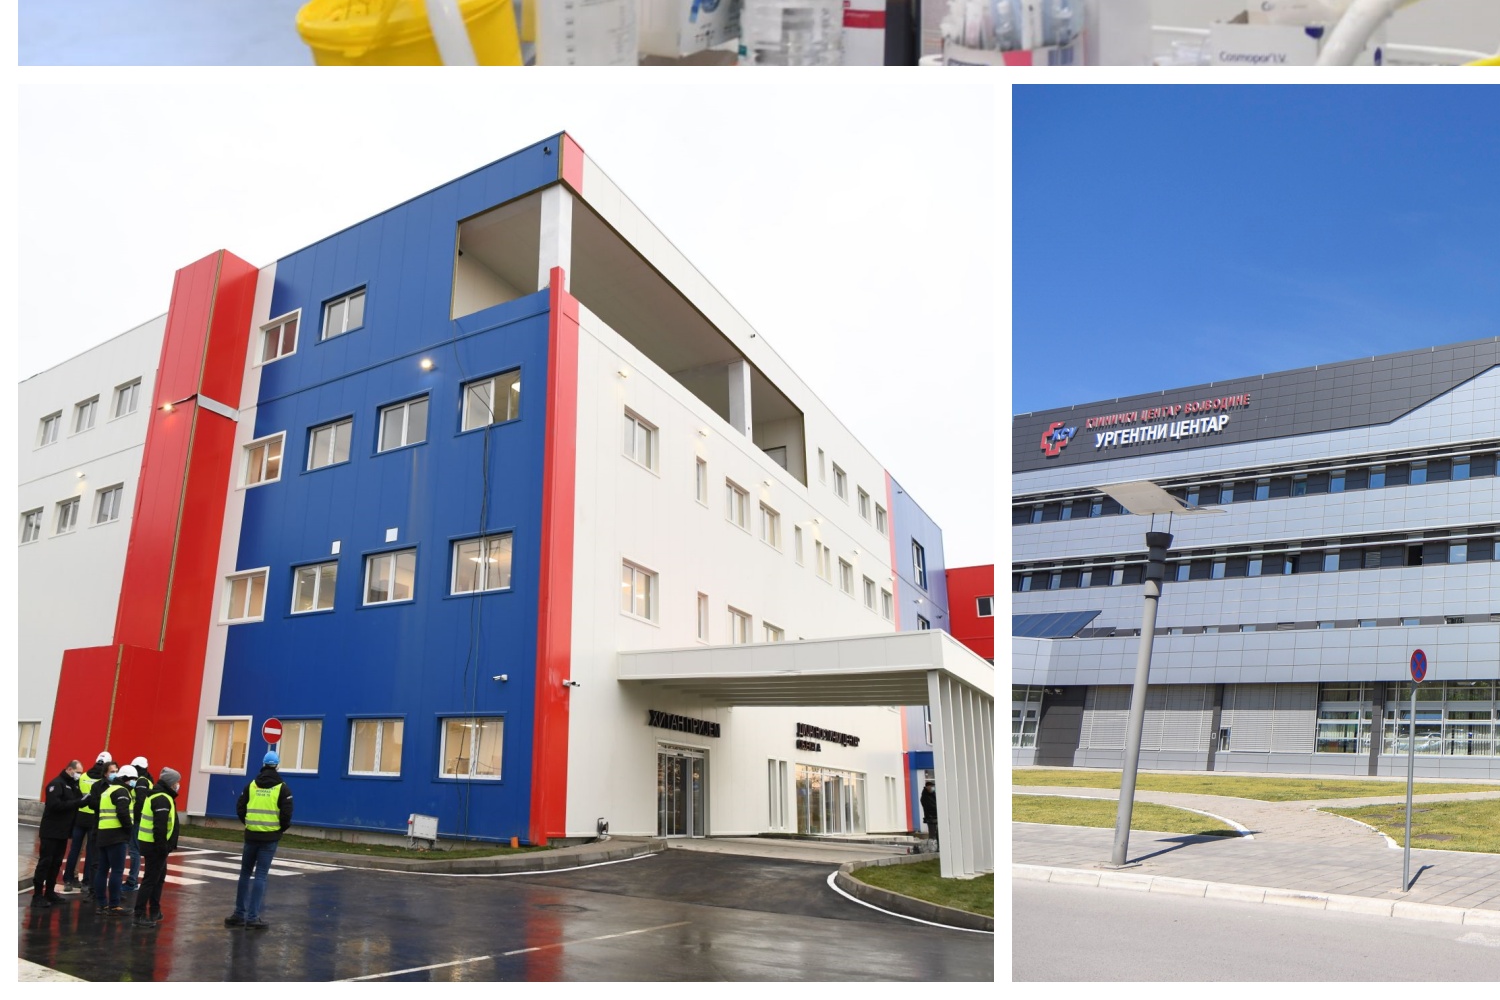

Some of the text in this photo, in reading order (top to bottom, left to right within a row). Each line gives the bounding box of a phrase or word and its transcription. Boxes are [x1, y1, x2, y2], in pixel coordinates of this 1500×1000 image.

[1085, 393, 1251, 429] КЛИНИЧКИ ЦЕНТАР ВОЈВОДИНЕ
[1095, 414, 1230, 448] УРГЕНТНИ ЦЕНТАР
[684, 716, 721, 738] ПРИЈЕМ
